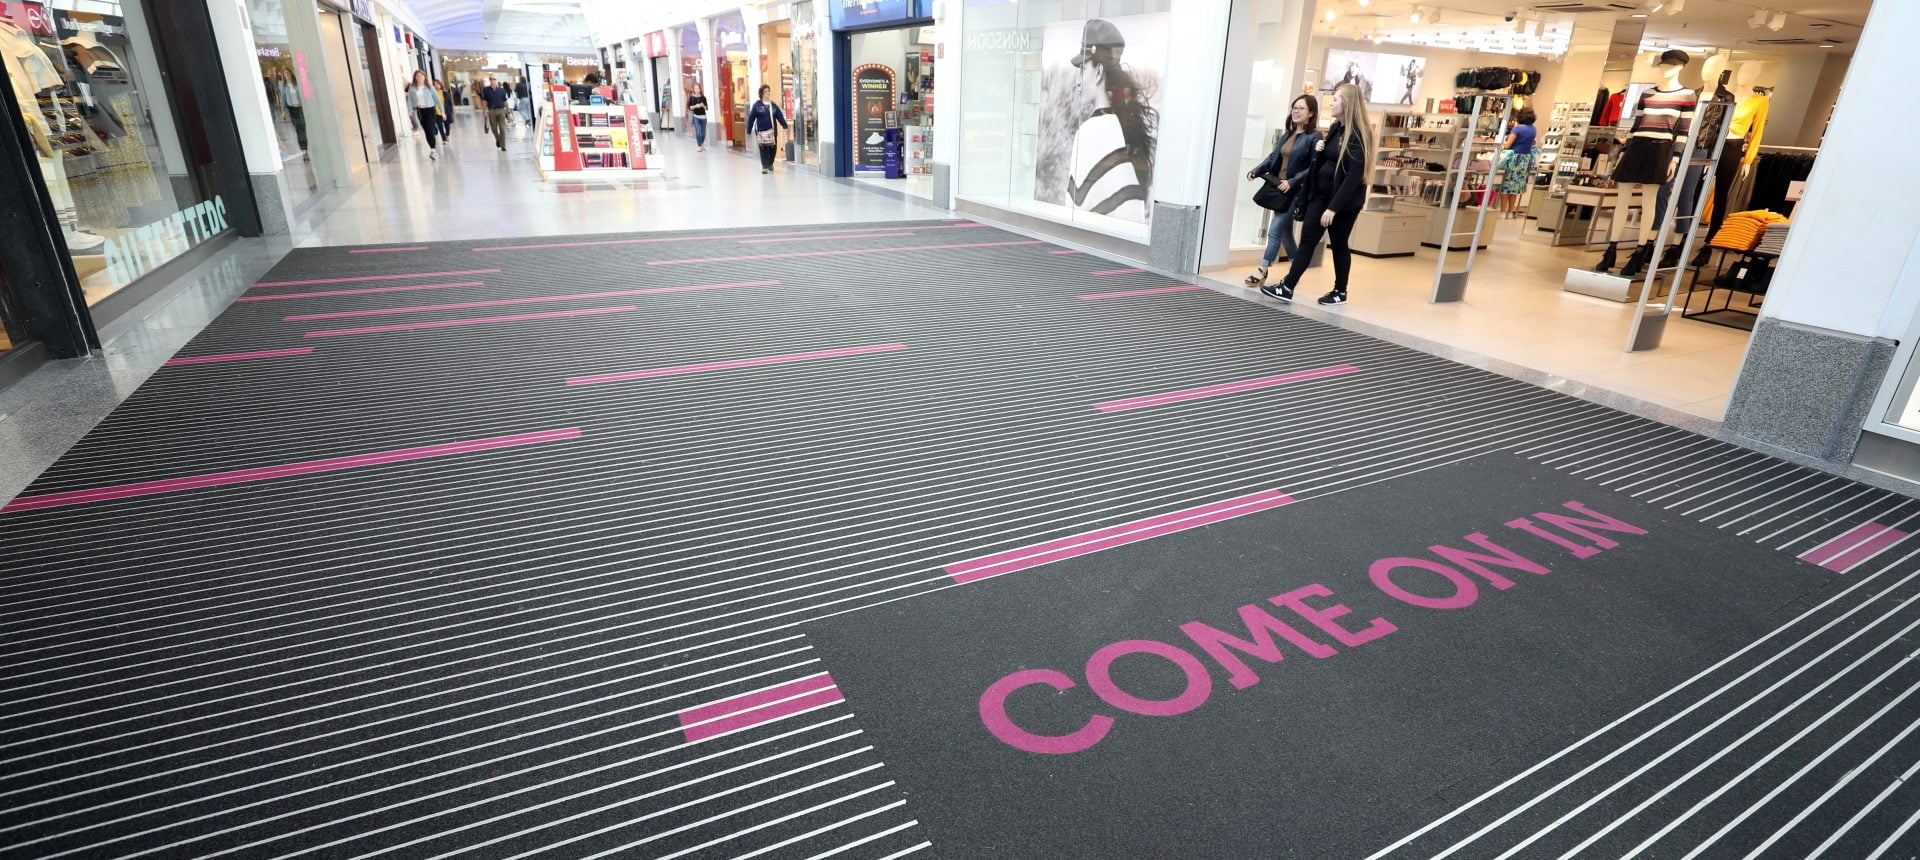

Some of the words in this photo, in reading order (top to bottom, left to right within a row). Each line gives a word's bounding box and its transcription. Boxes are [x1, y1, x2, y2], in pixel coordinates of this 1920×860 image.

[1275, 287, 1283, 295] N
[979, 583, 1399, 755] COME
[1368, 532, 1552, 609] ON
[1503, 501, 1650, 559] IN
